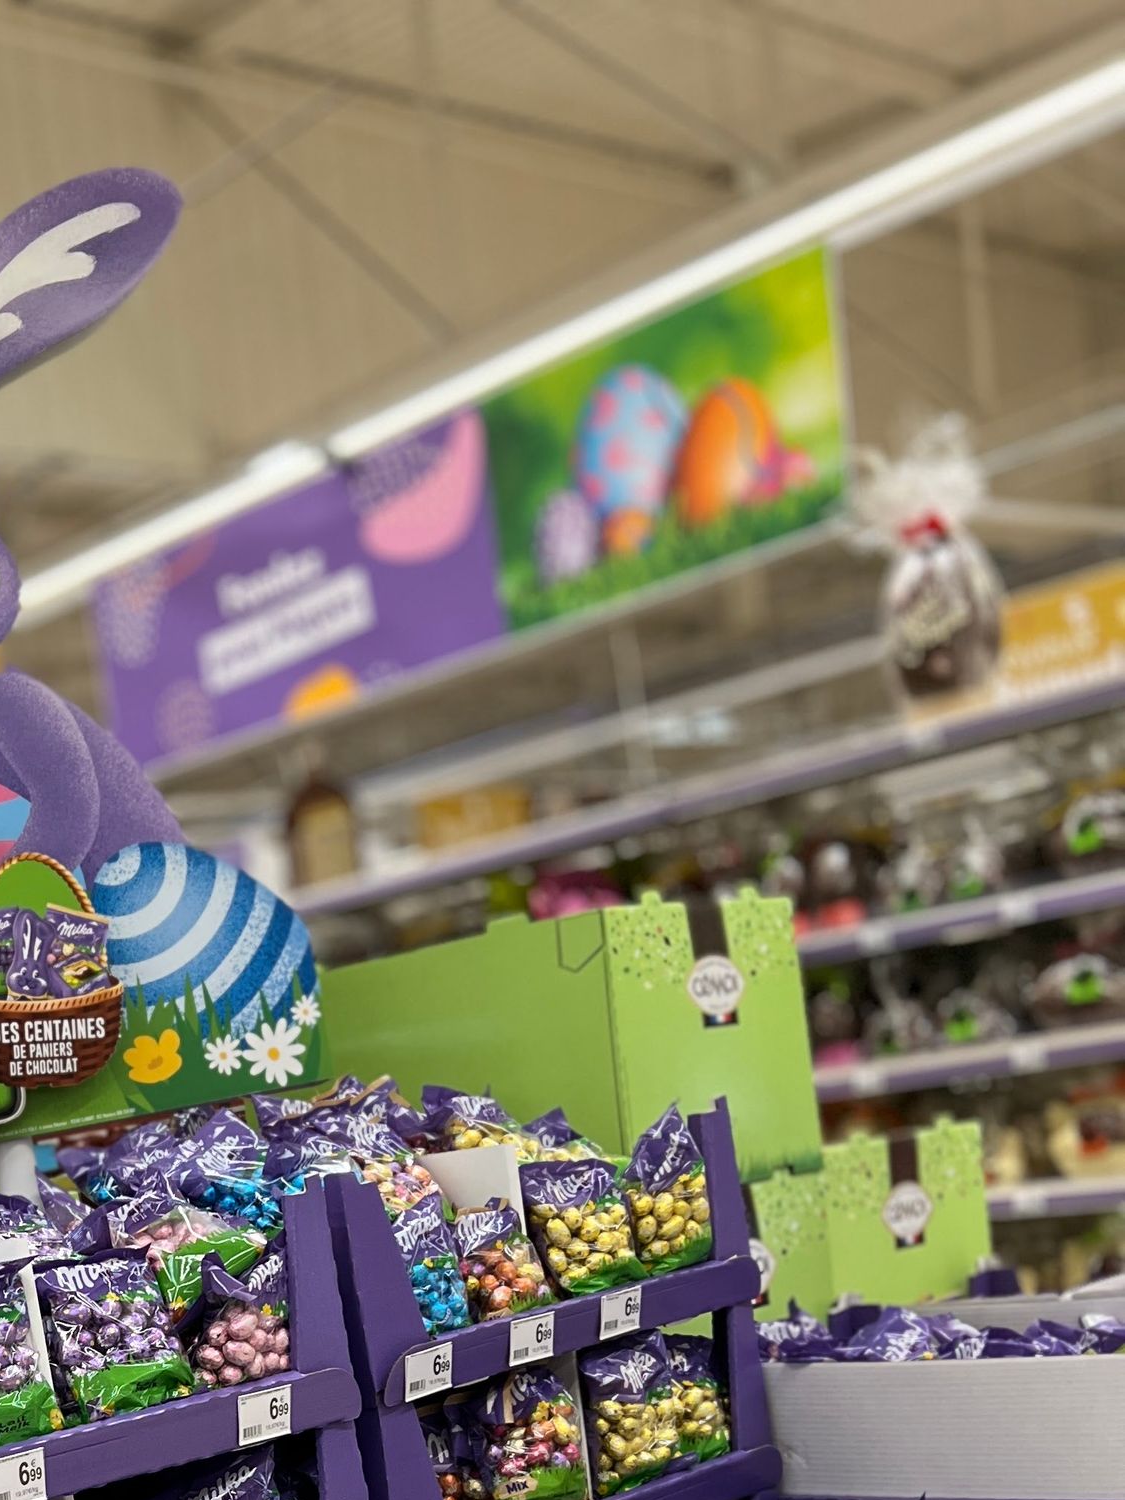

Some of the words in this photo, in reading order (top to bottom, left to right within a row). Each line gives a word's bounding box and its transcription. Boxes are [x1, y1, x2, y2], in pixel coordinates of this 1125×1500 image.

[57, 921, 95, 936] Milka
[25, 1017, 106, 1042] CENTAINES
[13, 1044, 27, 1060] DE
[29, 1042, 73, 1058] PANIERS
[10, 1061, 23, 1077] DE
[26, 1058, 79, 1075] CHOCOLAT
[505, 1479, 530, 1495] Mix
